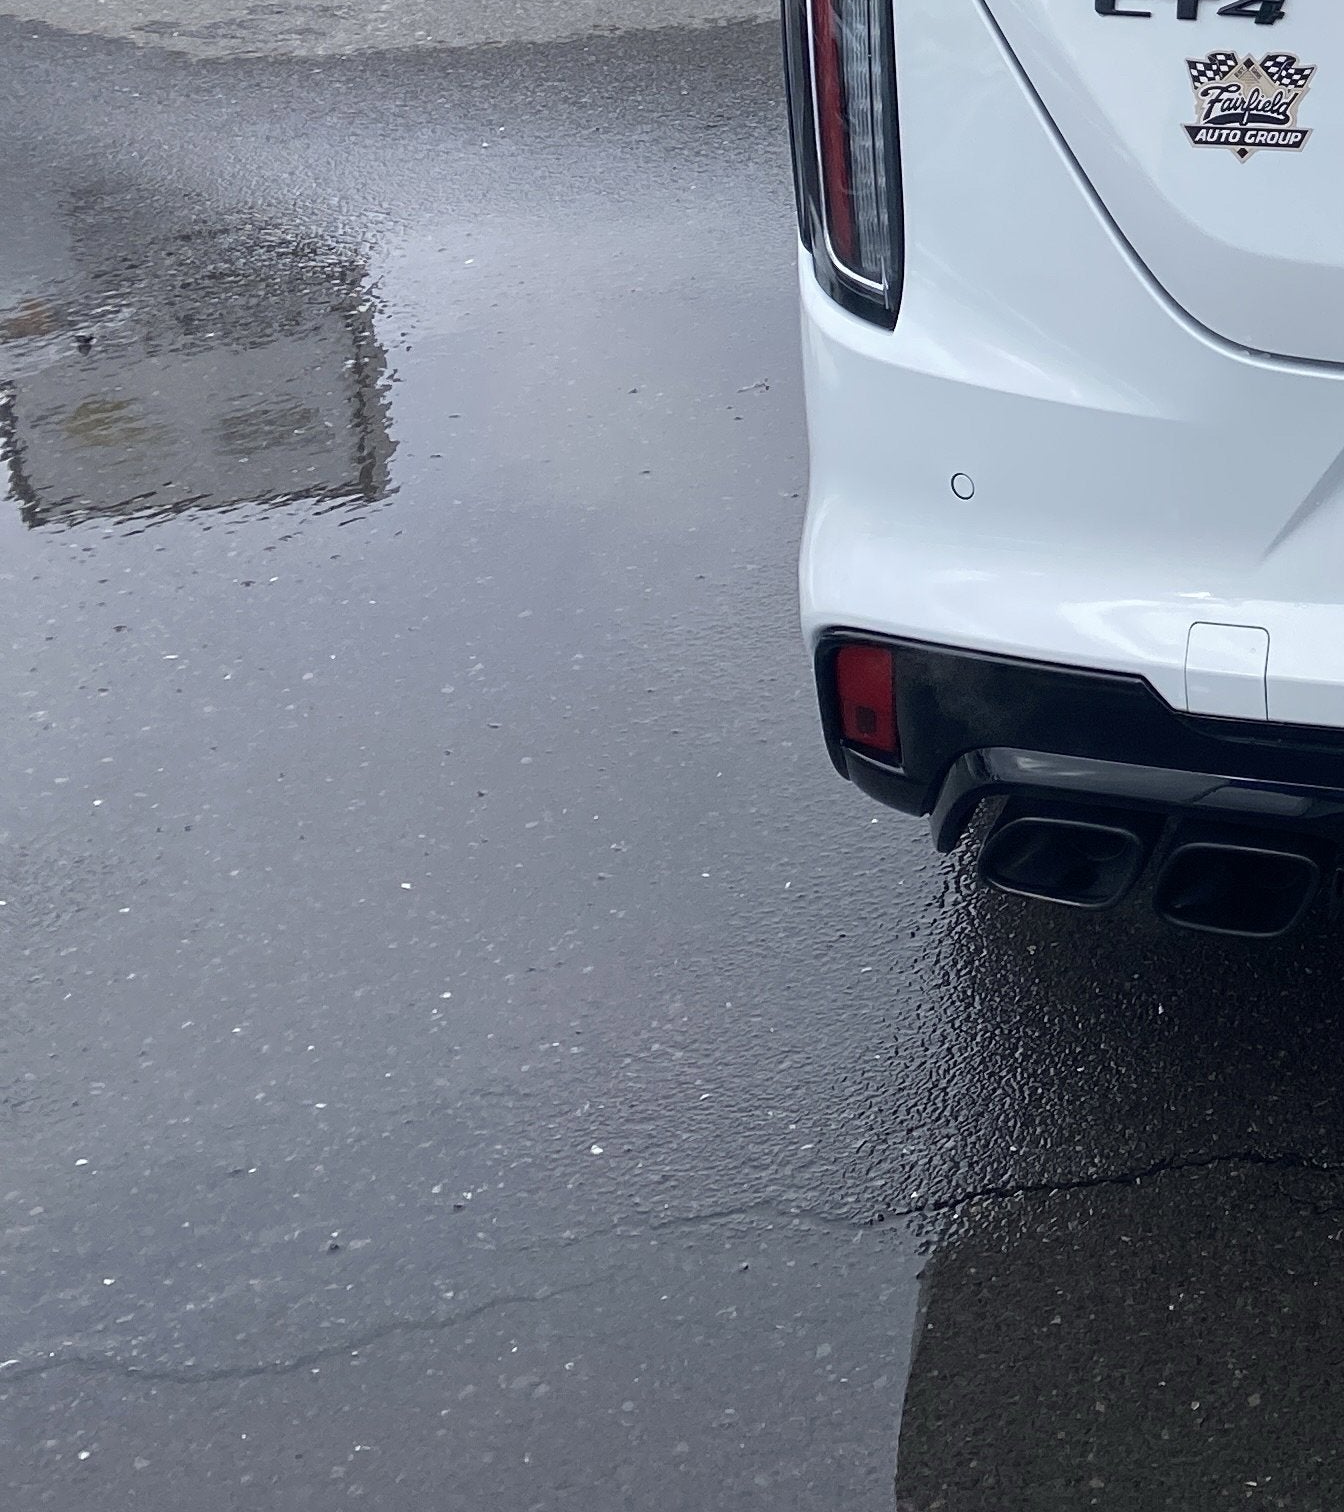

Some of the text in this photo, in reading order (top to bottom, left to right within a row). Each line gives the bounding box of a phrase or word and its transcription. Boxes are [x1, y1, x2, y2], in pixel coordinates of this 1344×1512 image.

[1200, 83, 1299, 126] Fairfield
[1195, 128, 1302, 145] AUTO GROUP
